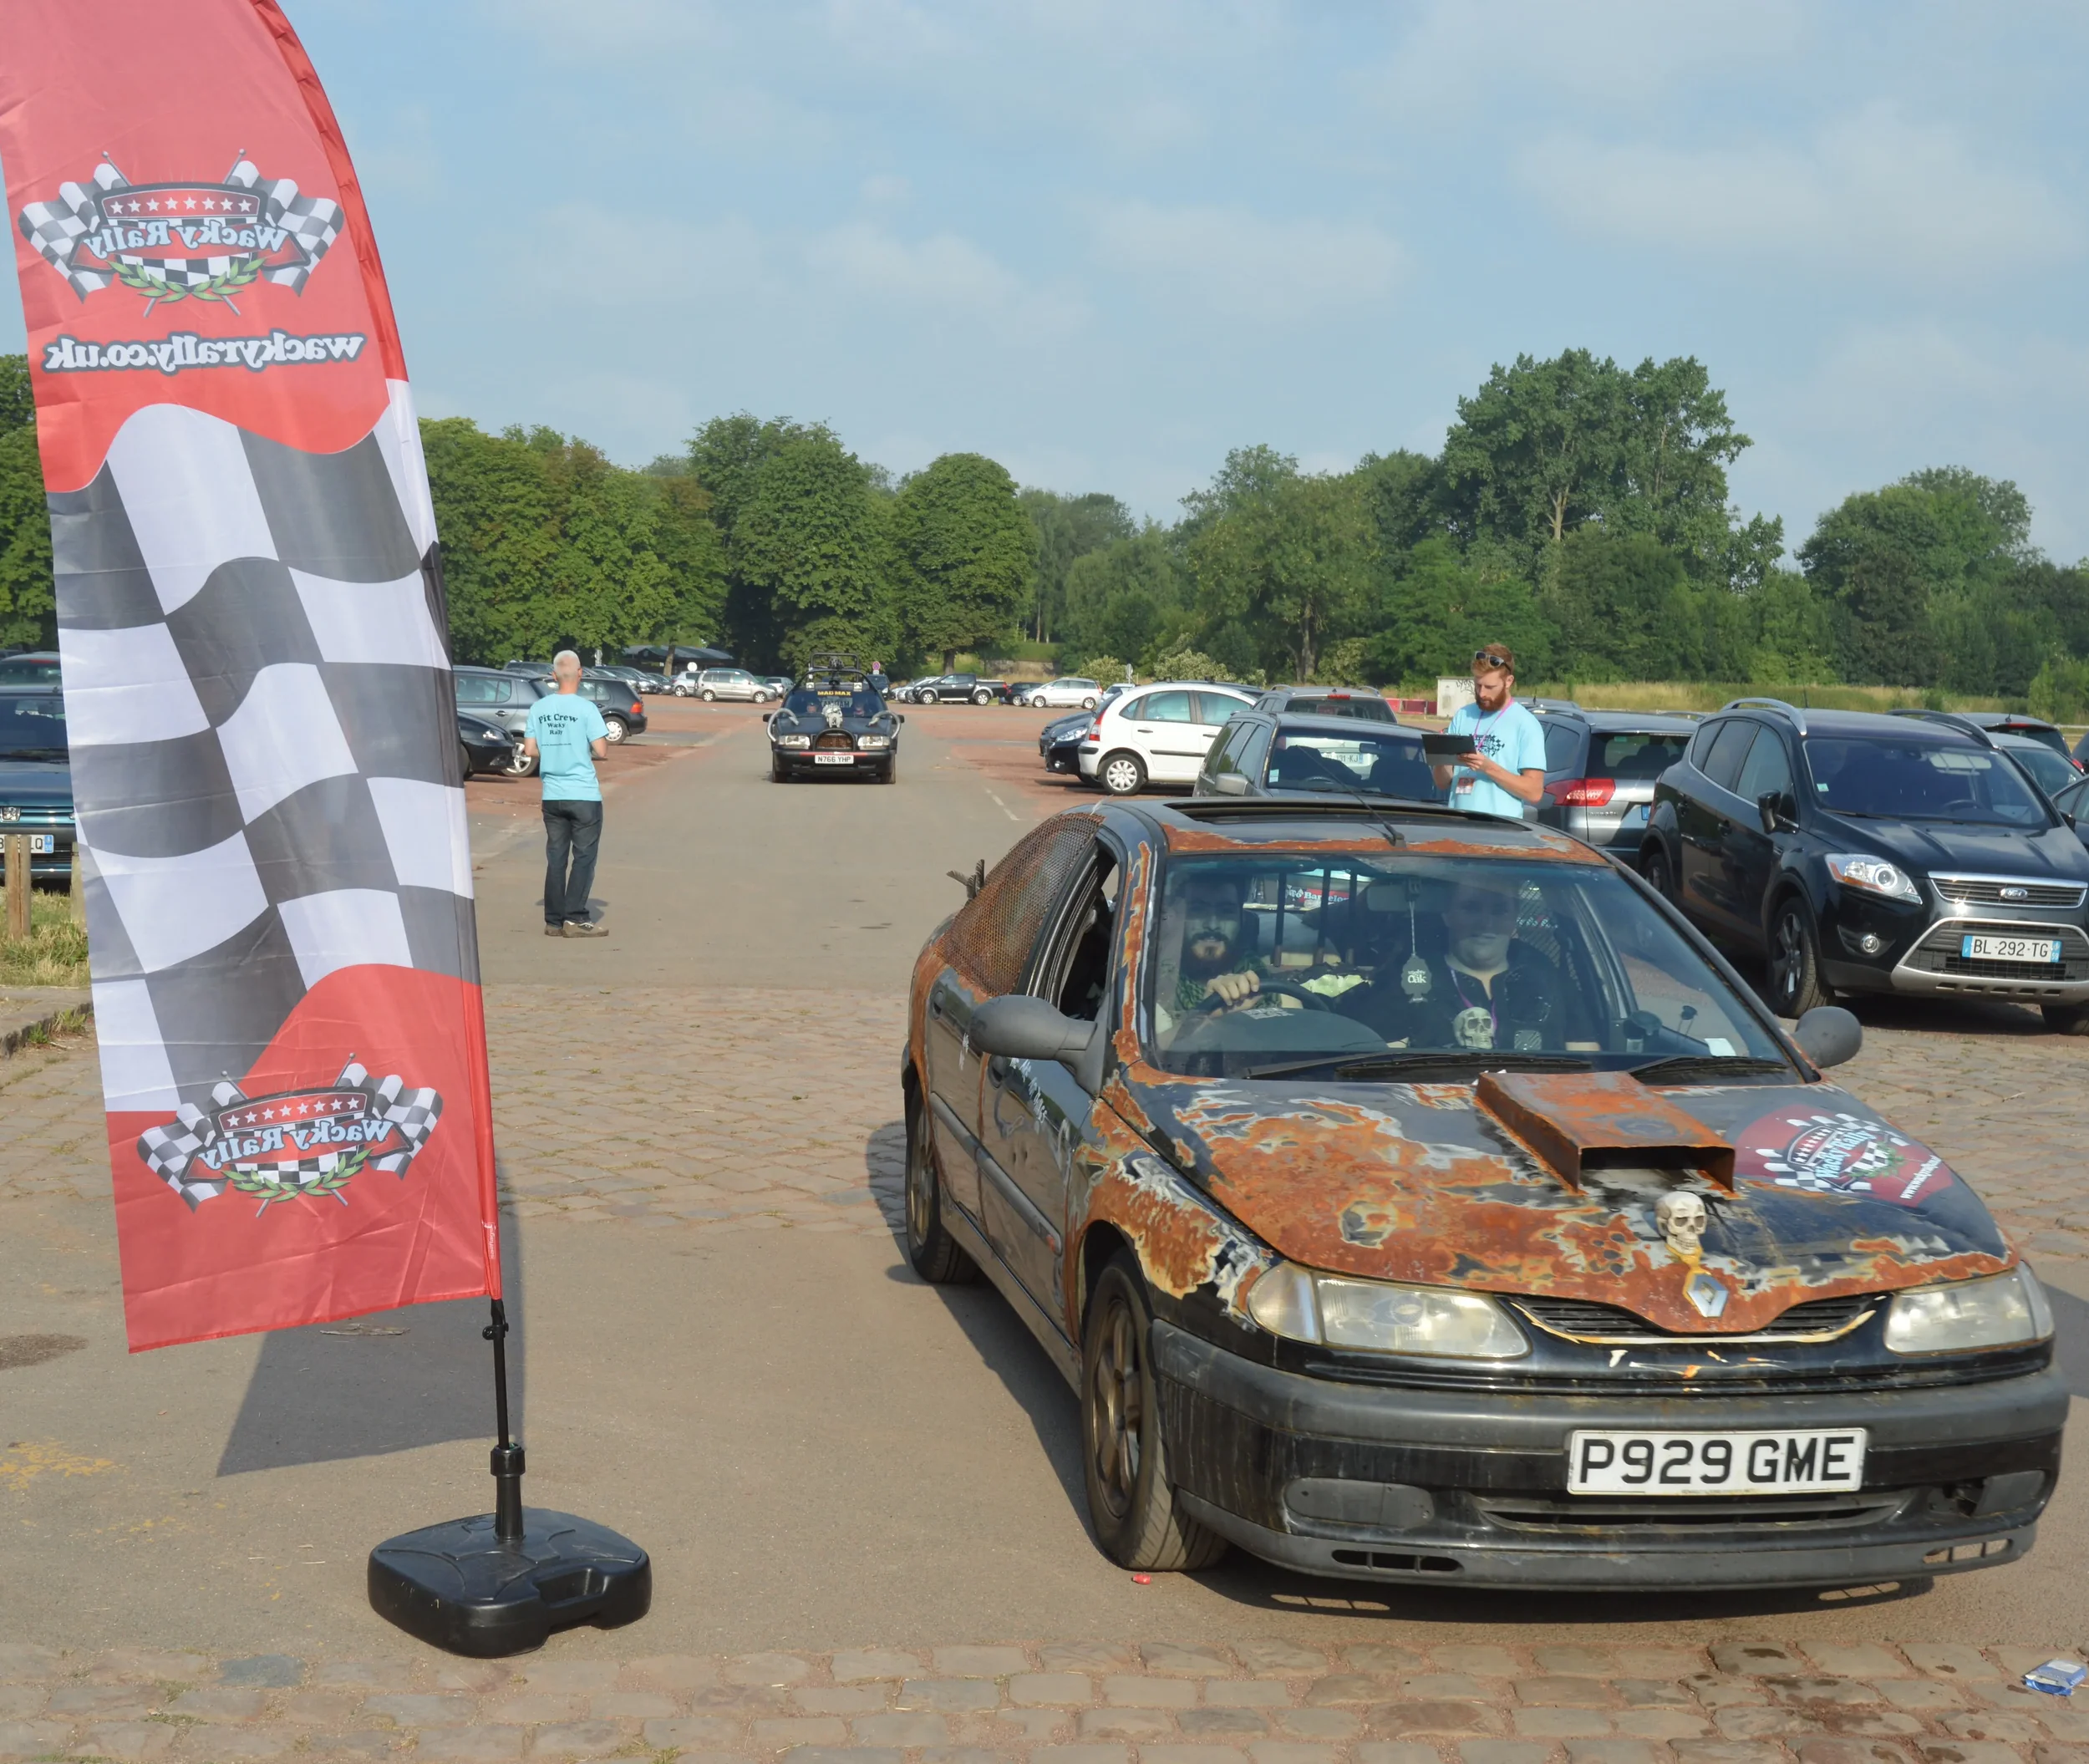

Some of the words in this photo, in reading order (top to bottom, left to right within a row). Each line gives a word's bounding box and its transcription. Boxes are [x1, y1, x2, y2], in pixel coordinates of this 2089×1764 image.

[538, 714, 551, 724] Pit
[553, 713, 578, 723] Crew
[1973, 939, 2049, 958] BL-292-TG
[1830, 1130, 1877, 1151] Rally
[1815, 1146, 1852, 1178] Wacky
[1579, 1438, 1733, 1484] P929
[1747, 1436, 1854, 1483] GME
